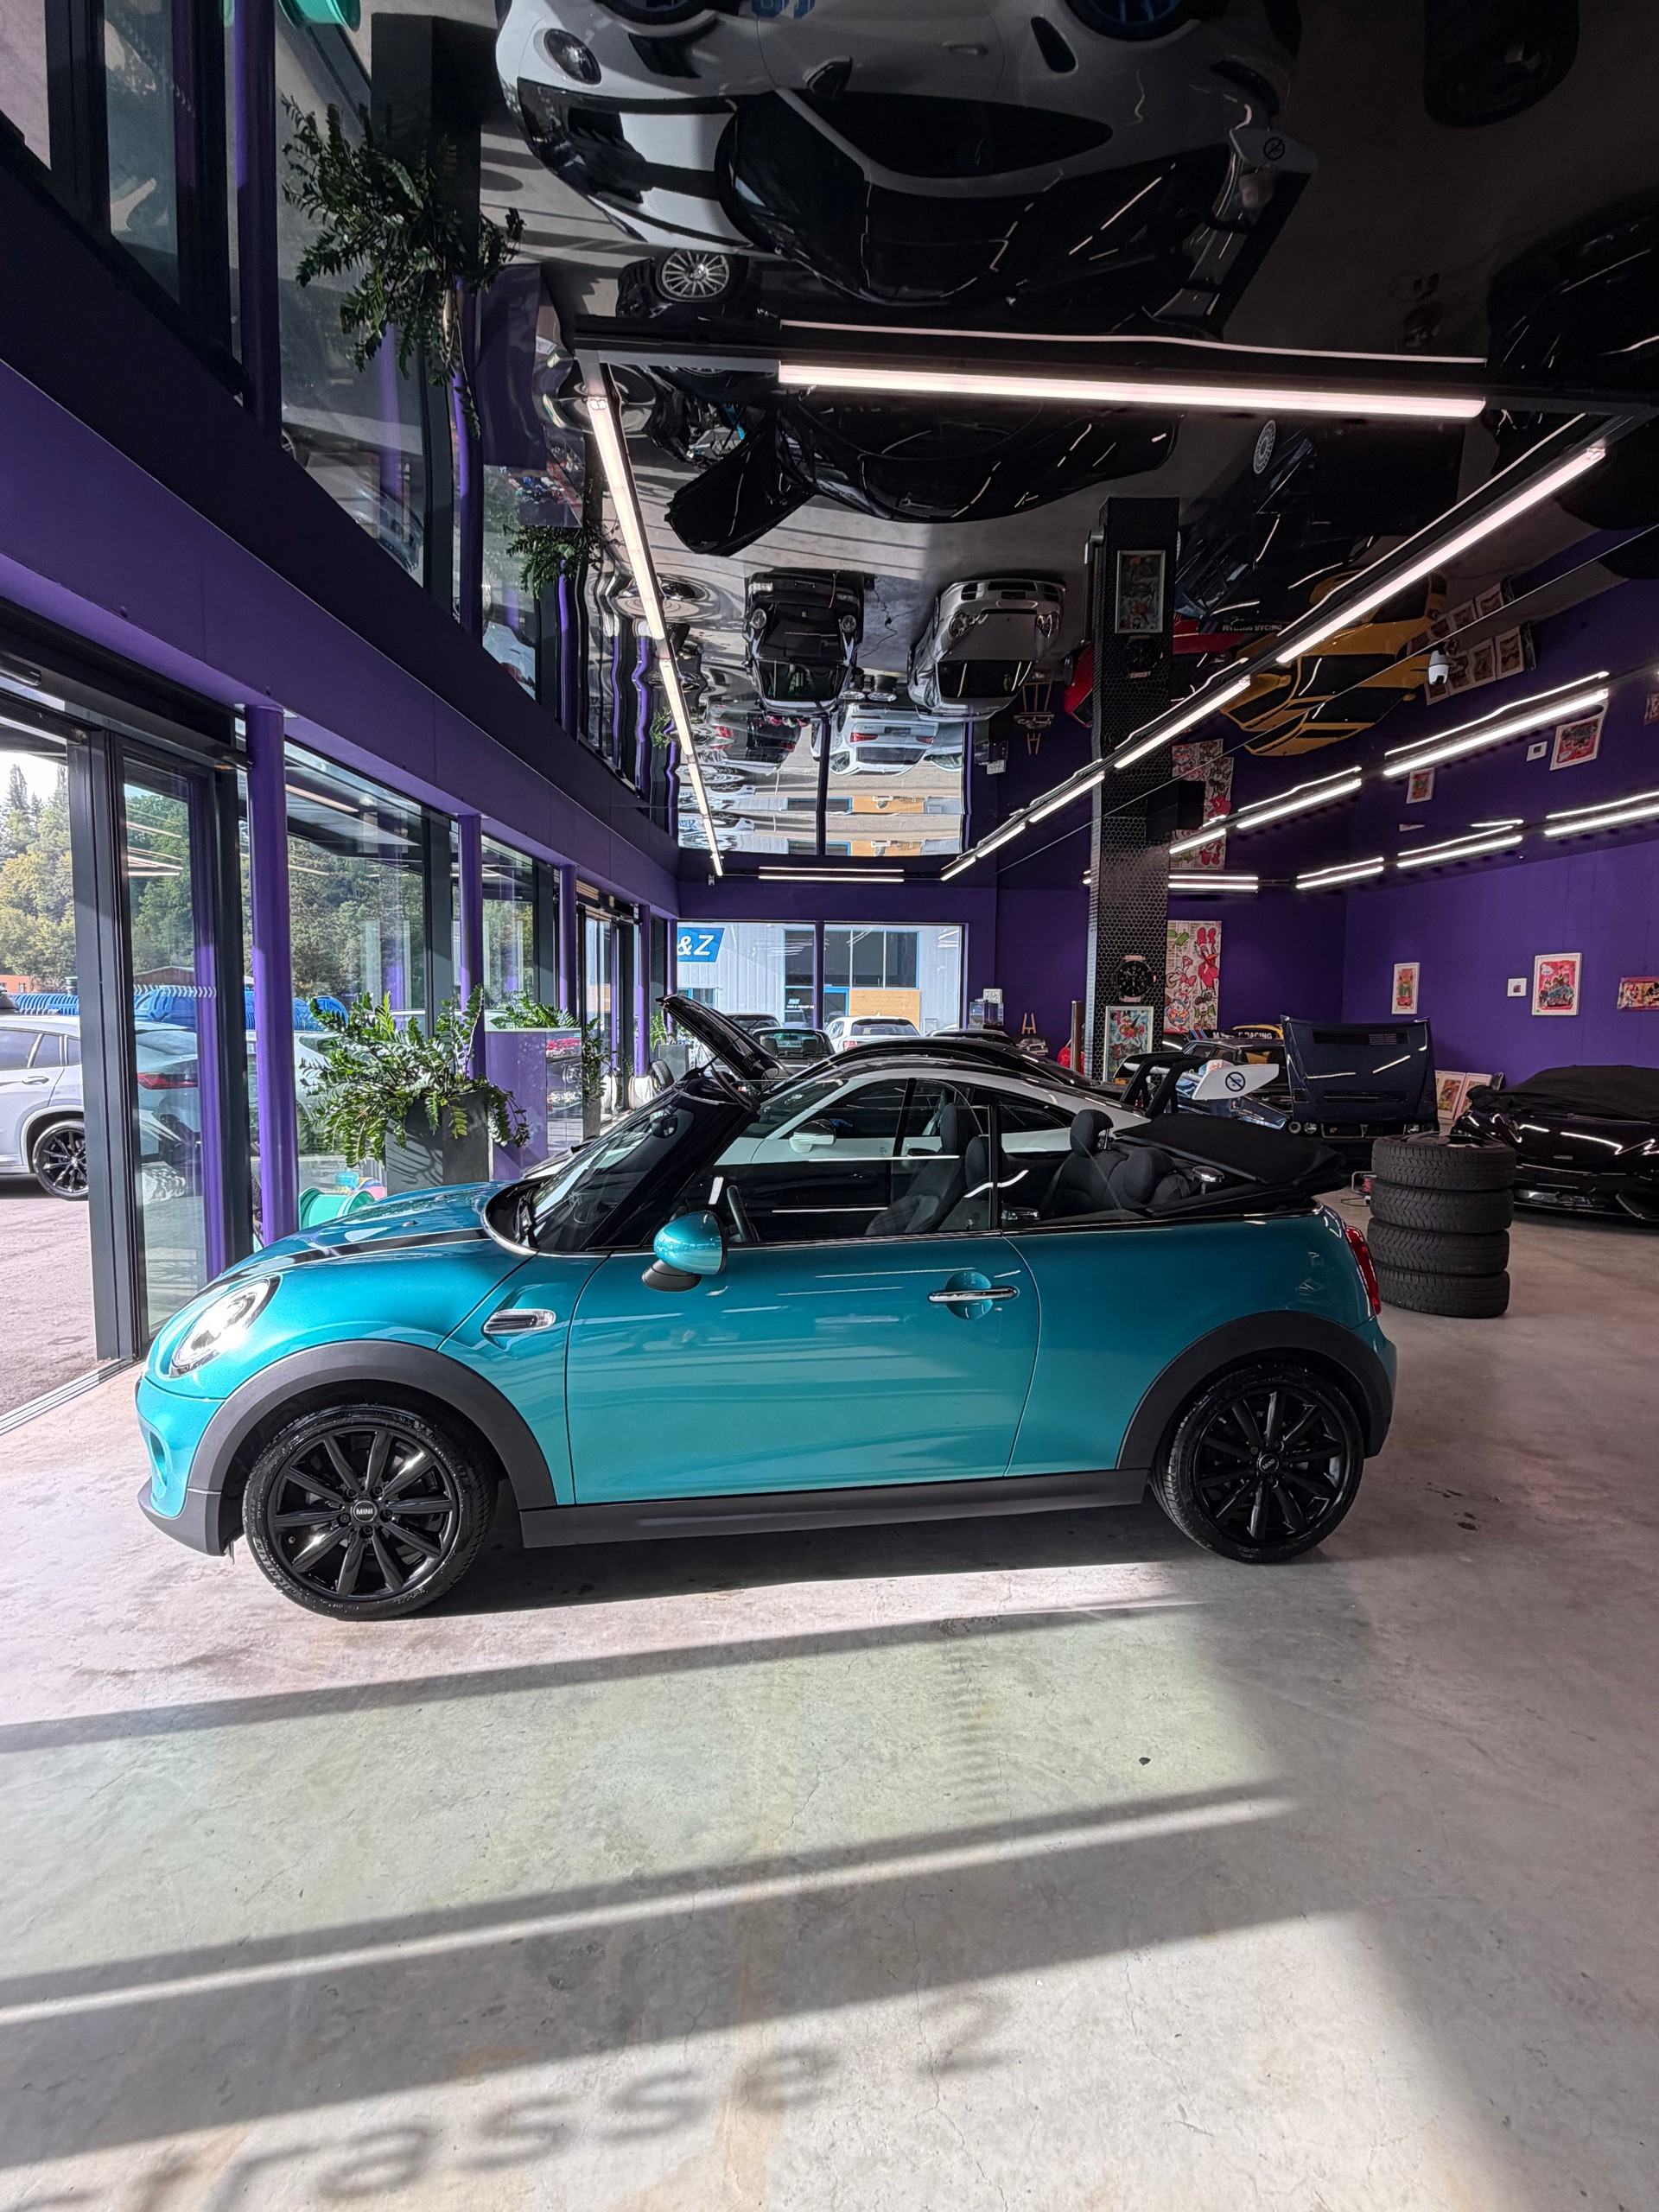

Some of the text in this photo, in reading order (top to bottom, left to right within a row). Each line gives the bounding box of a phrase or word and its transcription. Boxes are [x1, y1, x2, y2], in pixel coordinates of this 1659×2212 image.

[1262, 1459, 1275, 1470] MINI
[254, 1539, 299, 1597] MICHELIN
[2, 2044, 842, 2212] trasse
